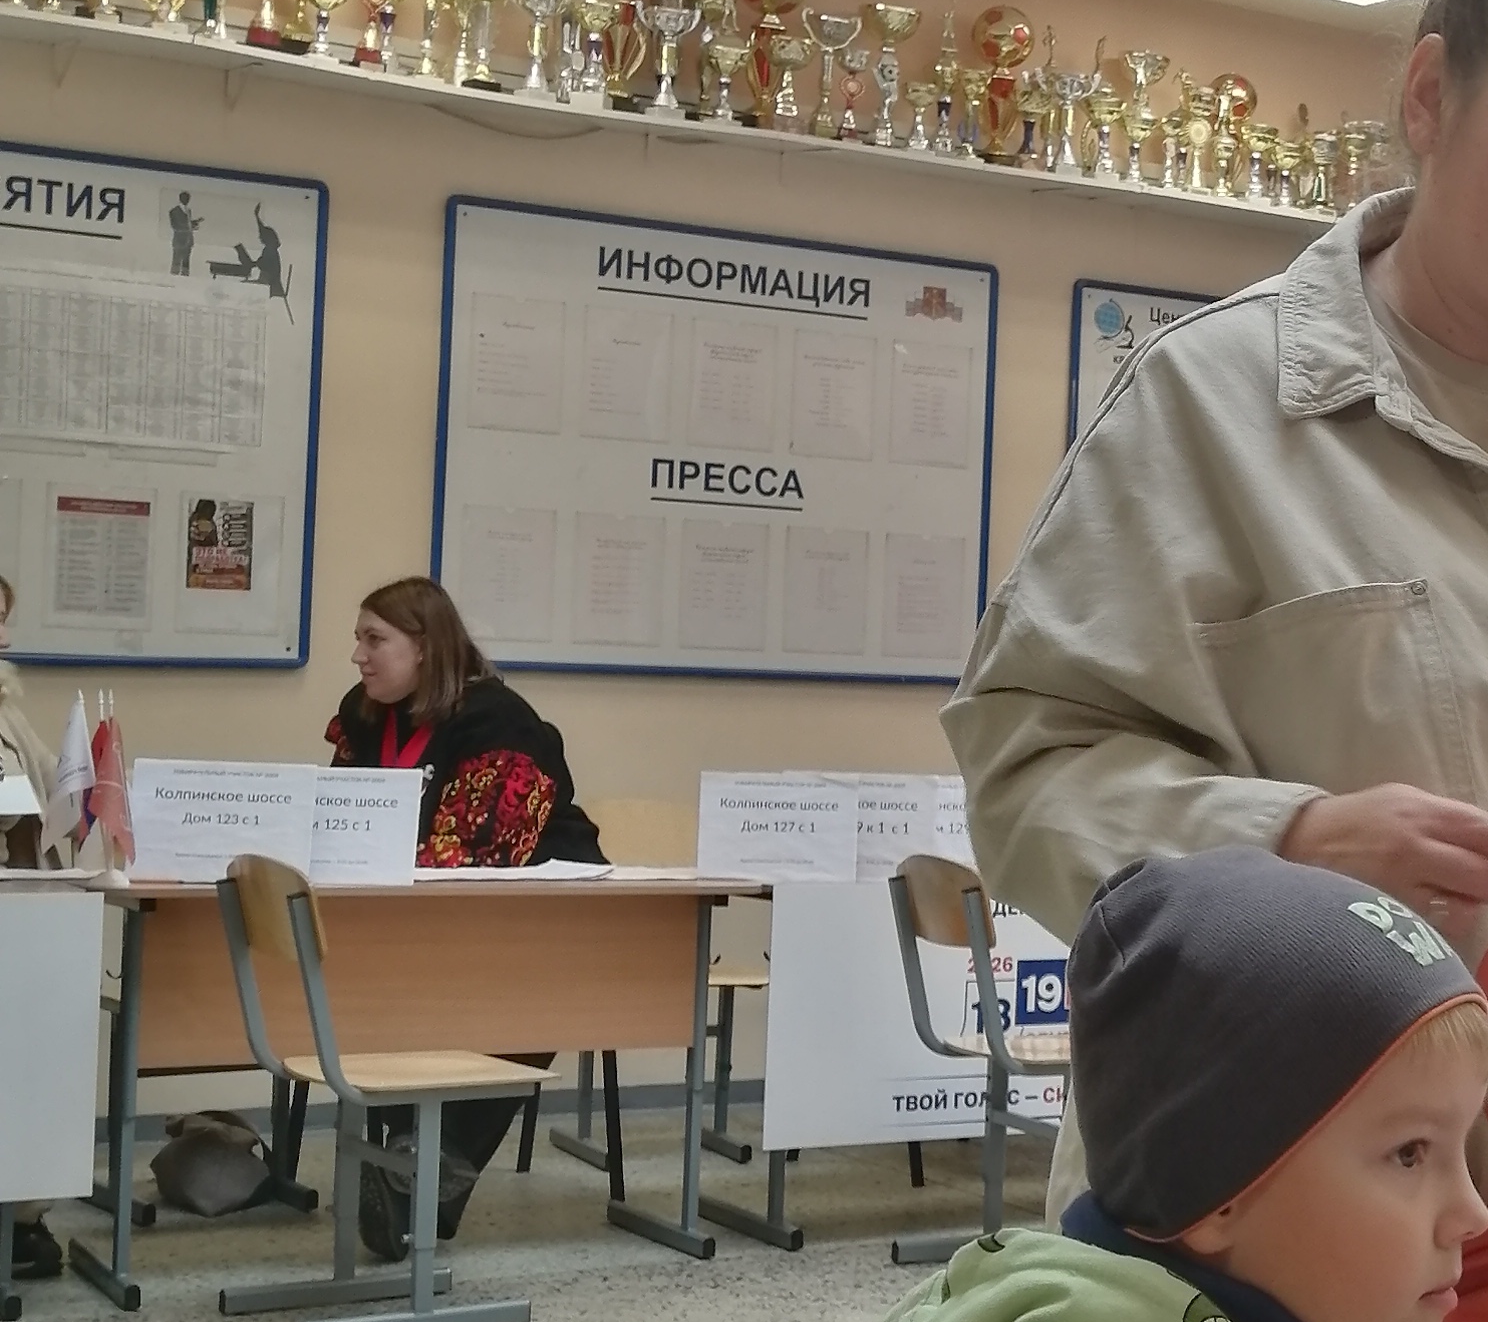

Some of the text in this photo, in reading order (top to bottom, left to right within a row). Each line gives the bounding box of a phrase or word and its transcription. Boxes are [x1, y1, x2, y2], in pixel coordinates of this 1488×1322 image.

[2, 175, 125, 223] ЯТИЯ
[597, 245, 871, 309] ИНФОРМАЦИЯ
[650, 457, 804, 499] ПРЕССА
[155, 786, 292, 805] Колпинское шоссе
[355, 797, 398, 809] шоссе
[720, 797, 839, 813] Колпинское шоссе
[880, 801, 918, 813] шоссе
[182, 811, 212, 826] Дом
[217, 813, 239, 825] 123
[254, 815, 260, 826] 1
[325, 818, 348, 831] 125
[365, 819, 371, 831] 1
[741, 820, 769, 834] Дом
[774, 821, 795, 834] 127
[809, 821, 816, 834] 1
[879, 822, 885, 834] 1
[904, 822, 910, 835] 1
[967, 957, 1013, 974] 226
[1021, 973, 1062, 1013] 19
[892, 1088, 948, 1113] ТВОЙ
